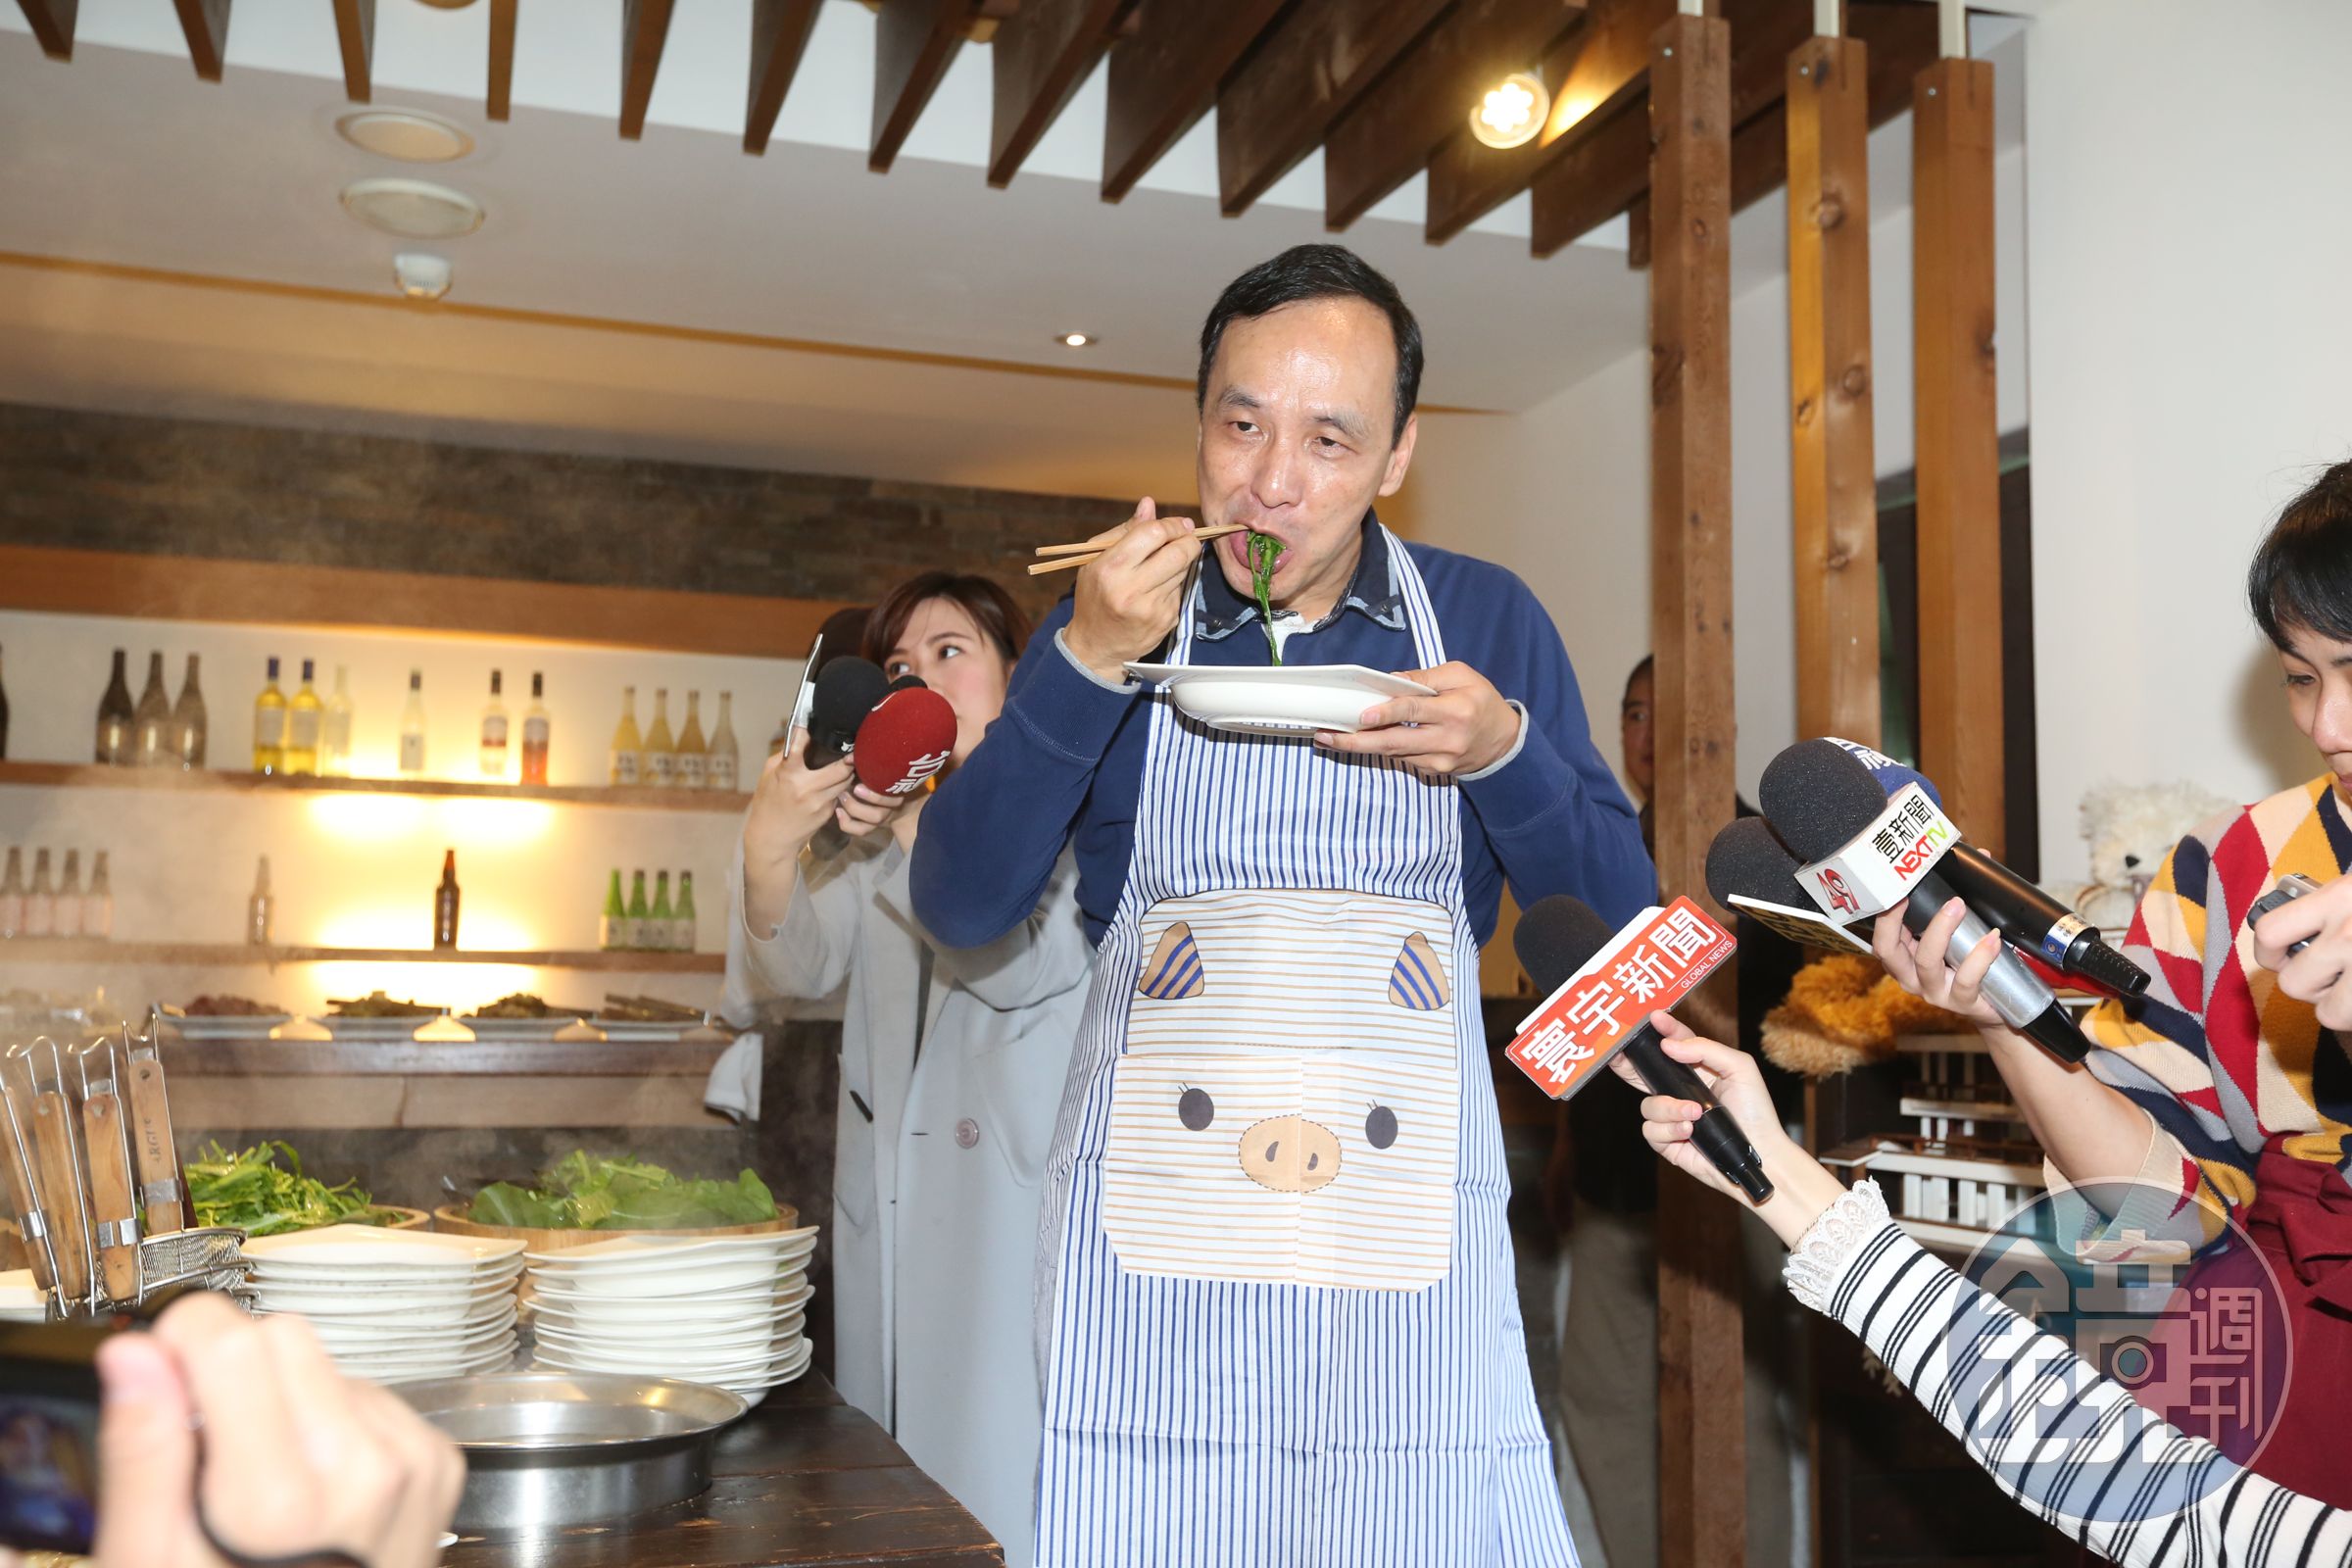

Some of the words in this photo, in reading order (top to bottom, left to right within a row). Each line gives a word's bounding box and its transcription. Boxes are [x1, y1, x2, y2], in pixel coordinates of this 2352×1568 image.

[1872, 795, 1935, 863] 壹新聞
[1816, 868, 1860, 914] 49
[1681, 961, 1712, 989] GLOBAL
[1708, 940, 1733, 962] NEWS
[1520, 906, 1717, 1084] 寰宇新聞
